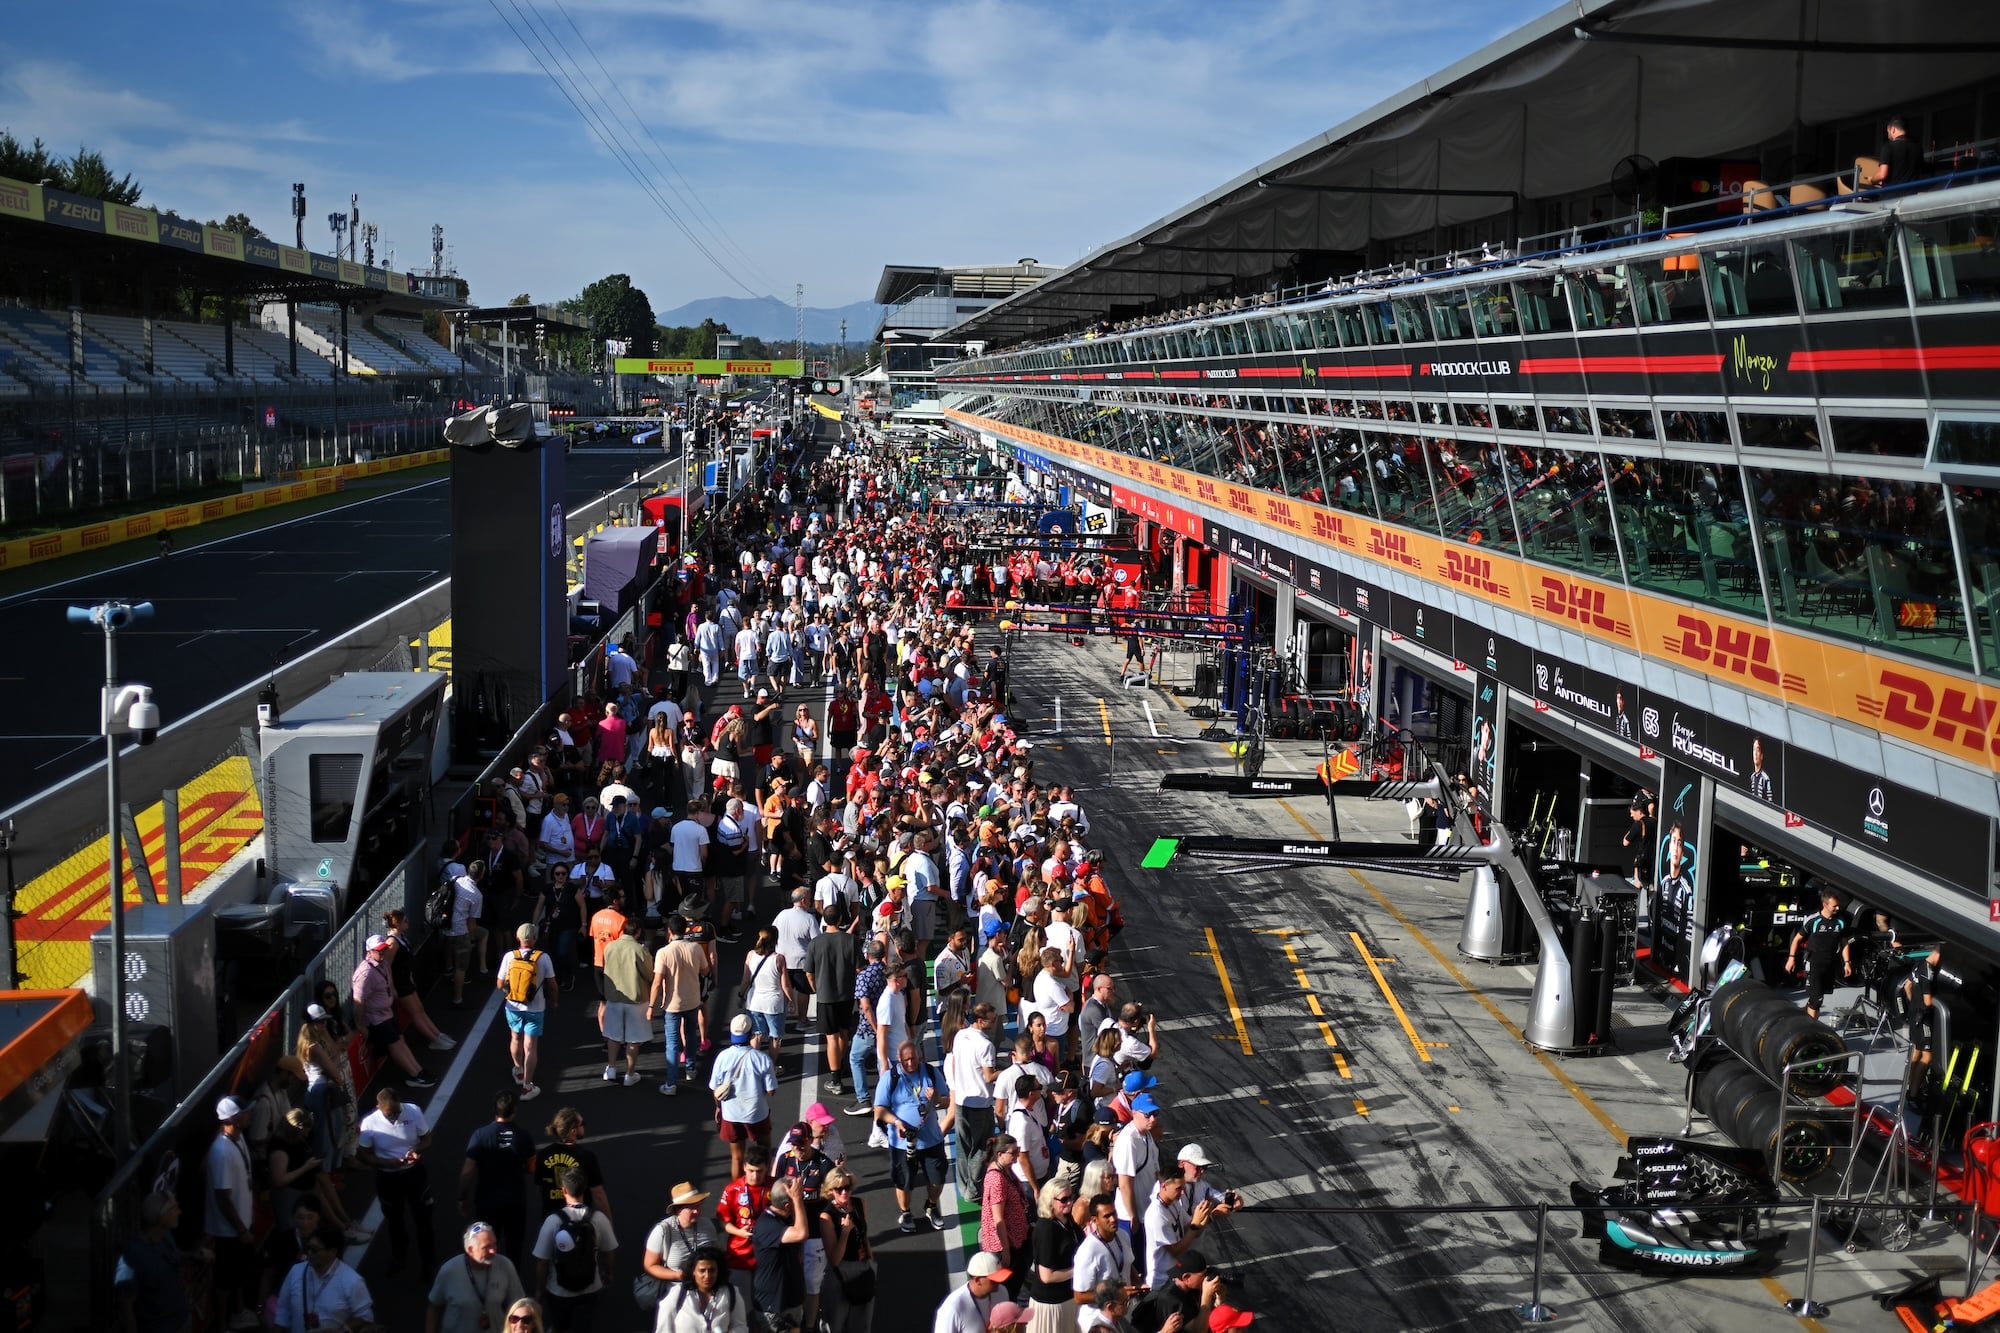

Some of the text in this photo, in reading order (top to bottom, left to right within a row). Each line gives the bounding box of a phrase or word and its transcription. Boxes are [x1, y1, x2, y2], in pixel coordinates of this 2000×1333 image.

[48, 199, 101, 222] P ZERO
[115, 209, 149, 236] PIRELLI
[161, 224, 201, 244] P ZERO
[246, 244, 277, 260] P ZERO
[318, 262, 337, 273] ZERO
[648, 361, 694, 373] PIRELLI
[726, 362, 772, 373] PIRELLI
[1430, 362, 1480, 377] PADDOCK
[1480, 361, 1511, 375] CLUB
[1733, 334, 1777, 391] Monza
[1230, 489, 1253, 514] DHL
[1268, 499, 1296, 527] DHL
[126, 516, 151, 537] PIRELLI
[165, 508, 190, 527] PIRELLI
[1314, 512, 1348, 544] DHL
[30, 535, 62, 559] PIRELLI
[81, 525, 110, 547] PIRELLI
[1370, 528, 1413, 566] DHL
[1444, 550, 1498, 594] DHL
[1542, 576, 1615, 632] DHL
[1677, 614, 1781, 685] DHL
[1536, 664, 1548, 691] 12
[1555, 686, 1611, 717] ANTONELLI
[1642, 707, 1660, 737] 63
[1672, 712, 1696, 754] George
[1672, 735, 1740, 776] RUSSELL
[1252, 781, 1292, 790] Einhell
[269, 784, 278, 827] PETRONAS
[1787, 812, 1801, 825] 14
[1283, 845, 1329, 854] Einhell
[1679, 991, 1698, 1014] INEOS
[1633, 1248, 1745, 1266] PETRONAS Syntium
